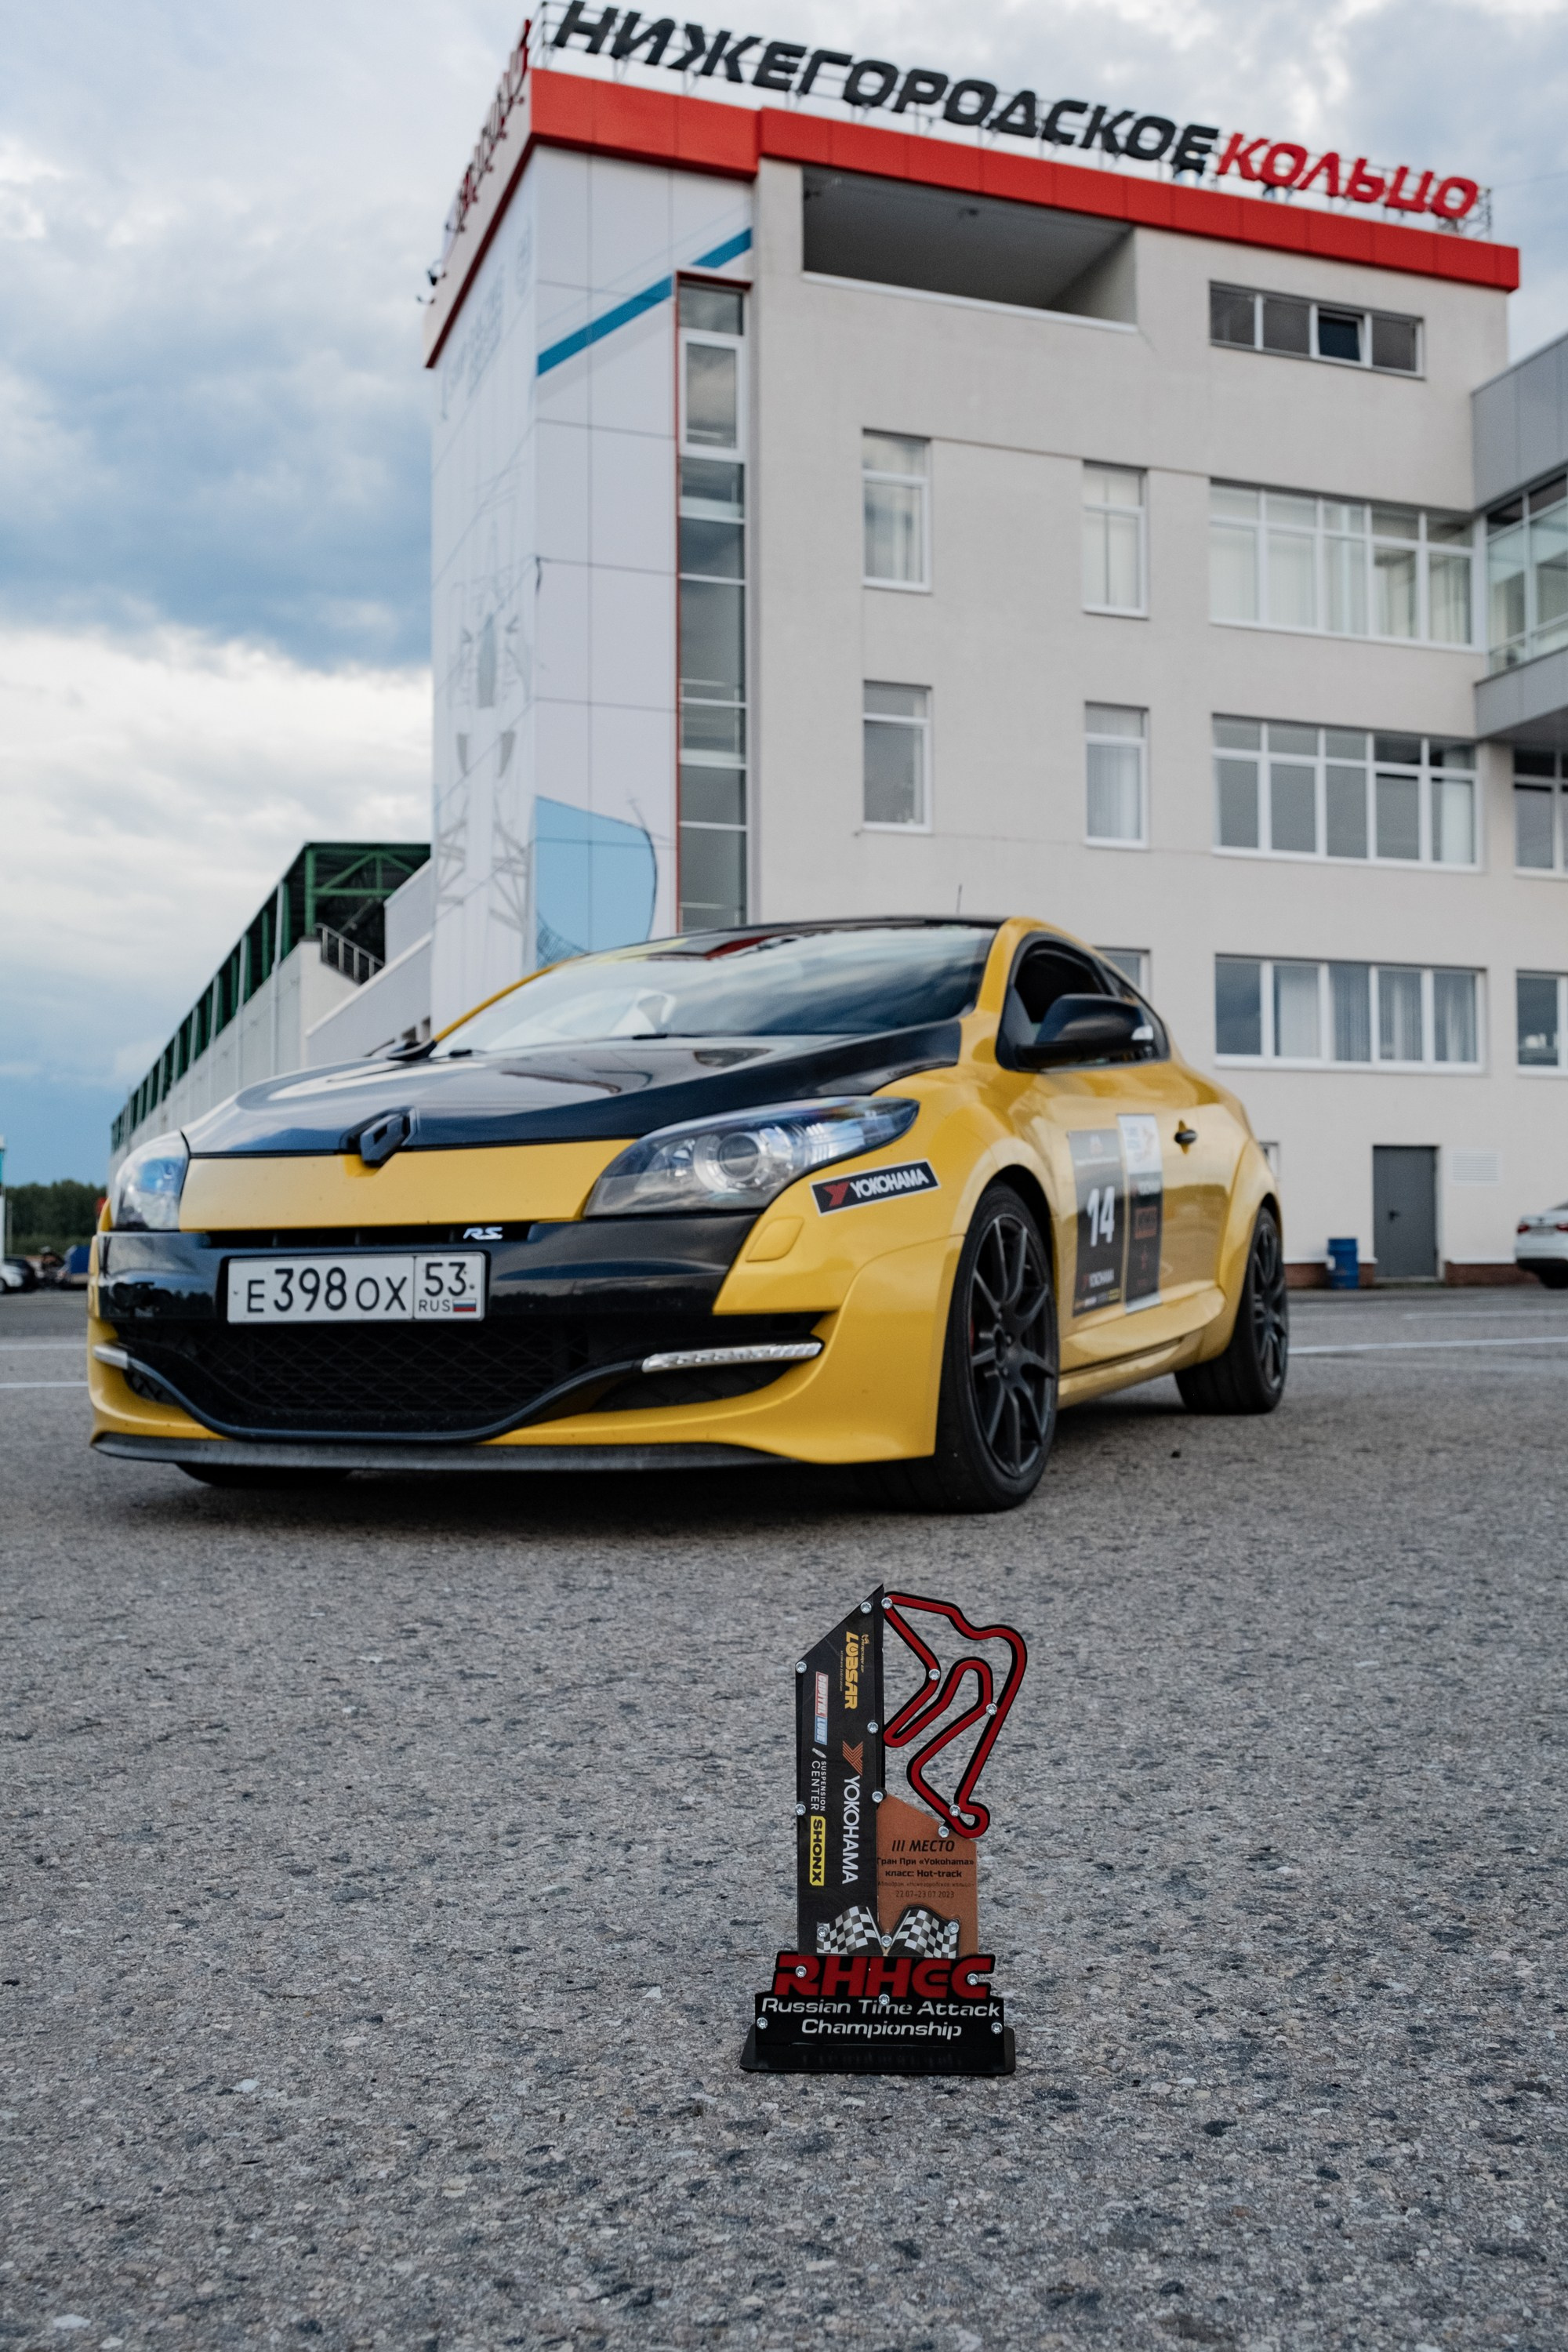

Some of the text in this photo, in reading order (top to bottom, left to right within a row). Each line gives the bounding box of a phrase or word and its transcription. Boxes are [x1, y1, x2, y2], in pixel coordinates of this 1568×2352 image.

[553, 0, 1219, 174] НИЖЕГОРОДСКОЕ
[1217, 132, 1479, 218] КОЛЬЦО
[850, 1168, 929, 1198] YOKOHAMA
[1087, 1185, 1115, 1248] 14
[463, 1227, 503, 1240] RS
[424, 1261, 467, 1297] 53
[418, 1298, 451, 1312] RUS
[816, 1675, 827, 1743] CAPITAL LUBE
[811, 1760, 821, 1810] CENTER
[842, 1775, 861, 1884] YOKOHAMA
[891, 1839, 955, 1852] III МЕСТО
[812, 1819, 823, 1882] SHONX
[877, 1857, 897, 1866] Гран
[899, 1857, 916, 1866] При
[761, 1998, 1000, 2016] Russian Time Attack
[800, 2019, 963, 2039] Championship
